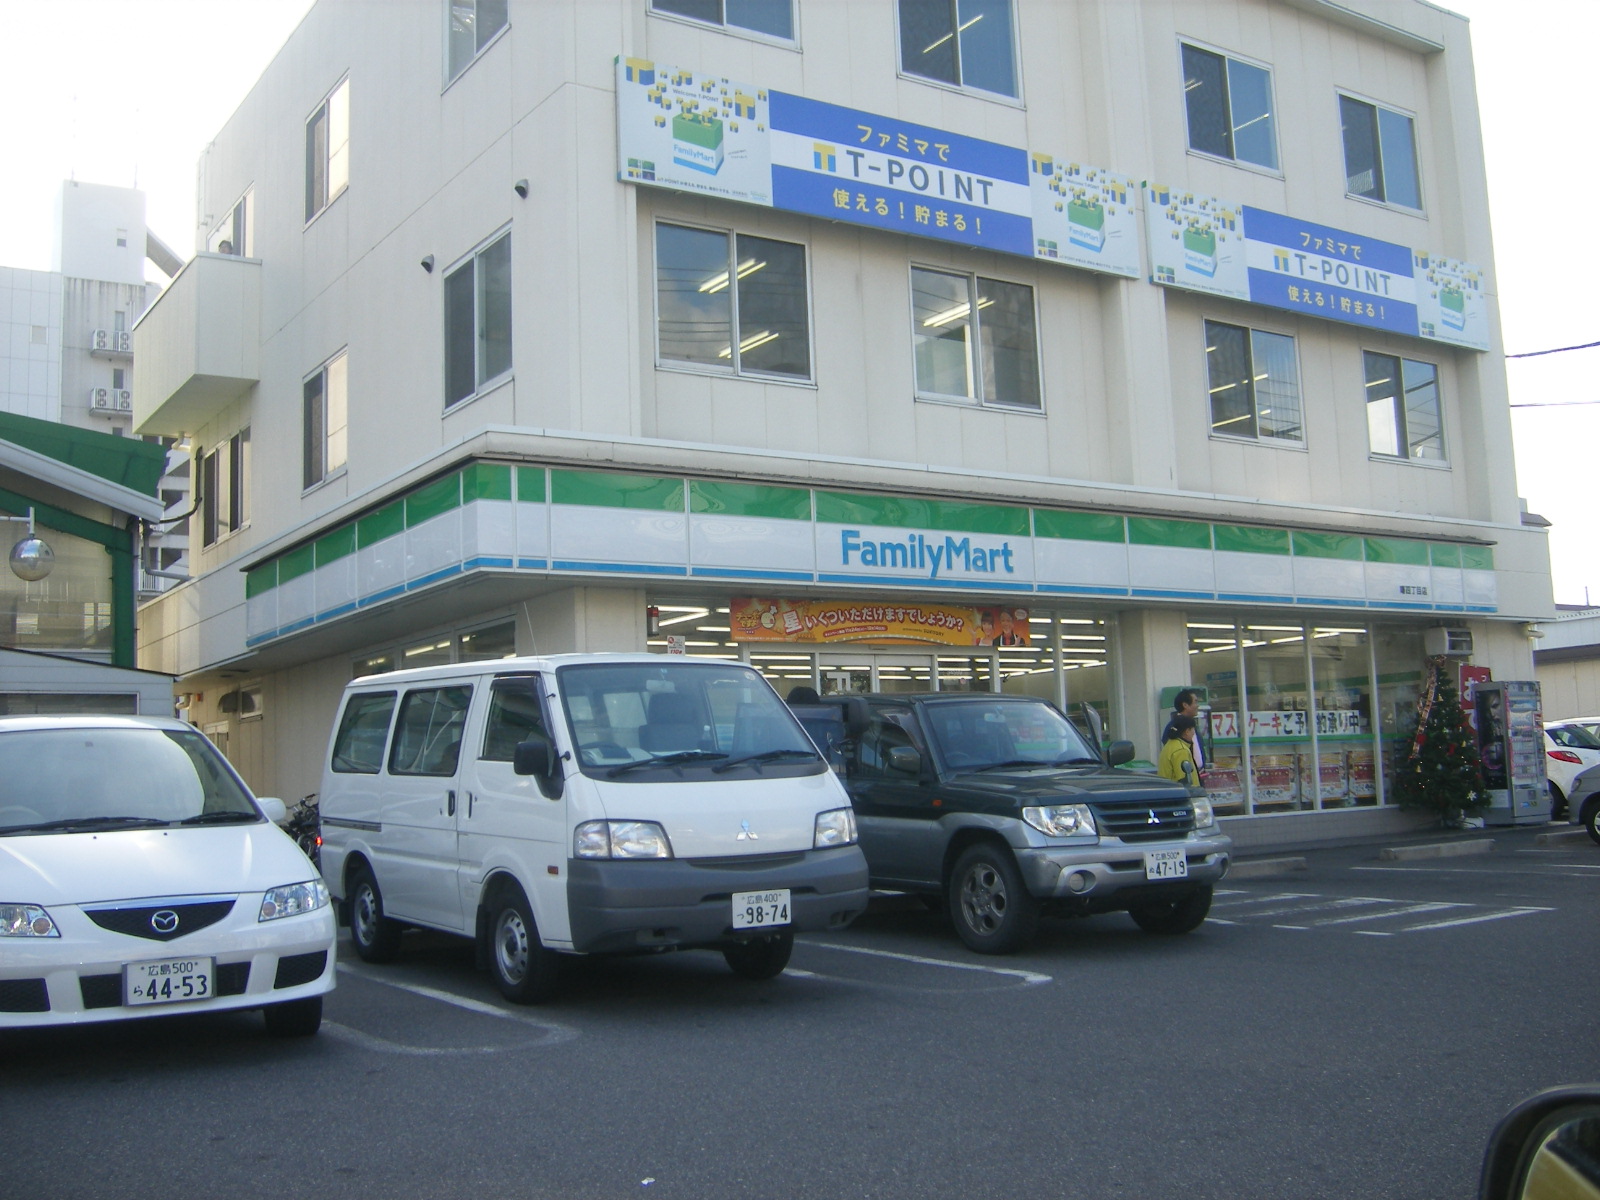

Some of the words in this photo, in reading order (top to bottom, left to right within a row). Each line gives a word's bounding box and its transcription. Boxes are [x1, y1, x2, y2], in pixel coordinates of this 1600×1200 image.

[672, 88, 697, 99] Welcome
[673, 143, 715, 165] FamilyMart
[856, 124, 951, 162] ファミマで
[846, 149, 994, 205] T-POINT
[1069, 226, 1099, 242] FamilyMart
[1299, 231, 1362, 261] ファミマで
[1294, 253, 1391, 295] T-POINT
[841, 529, 1014, 580] FamilyMart
[1156, 860, 1185, 877] 47-19
[746, 904, 788, 924] 98-74
[147, 961, 194, 977] 広島500
[133, 985, 143, 997] ら
[146, 974, 207, 1000] 44-53
